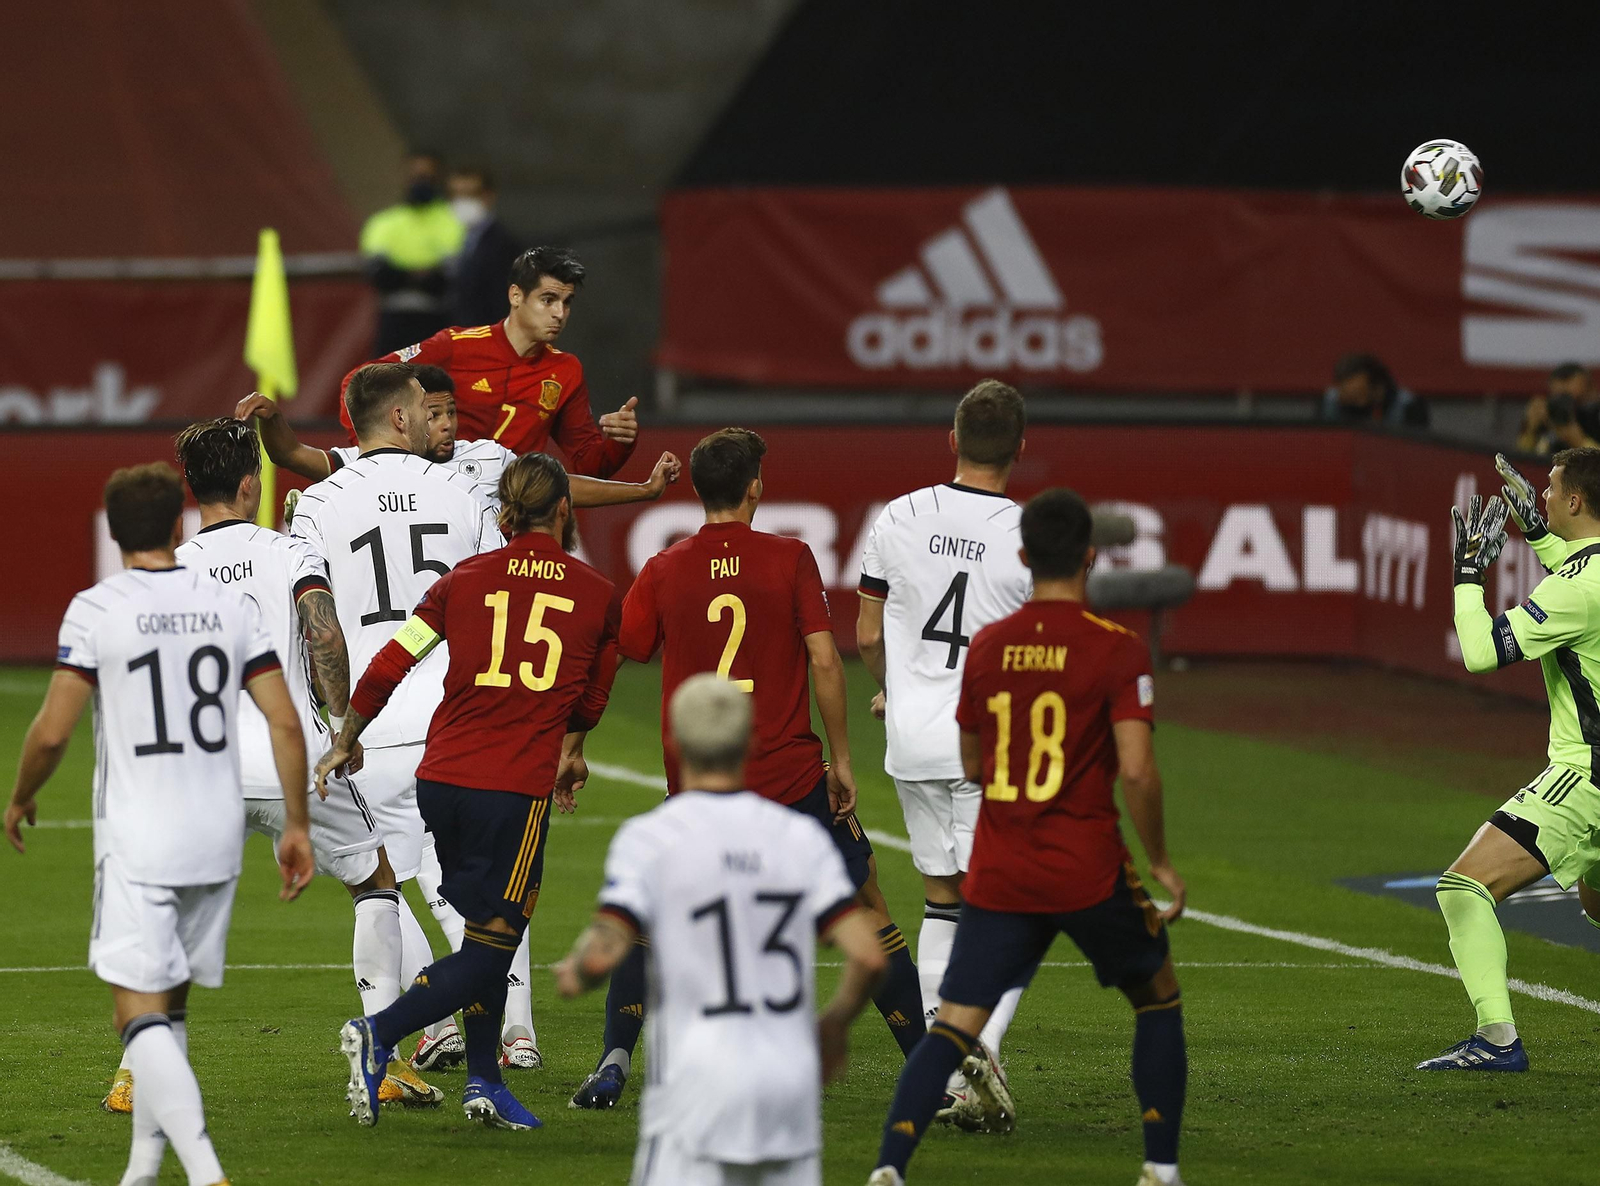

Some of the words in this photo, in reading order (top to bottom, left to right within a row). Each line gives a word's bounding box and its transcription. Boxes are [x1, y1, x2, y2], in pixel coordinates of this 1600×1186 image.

[847, 303, 1104, 371] adidas
[493, 403, 516, 440] 7
[378, 493, 417, 512] SÜLE
[209, 560, 253, 584] KOCH
[507, 558, 566, 581] RAMOS
[710, 556, 740, 580] PAU
[929, 534, 985, 562] GINTER
[1197, 504, 1359, 592] AL
[137, 612, 223, 635] GORETZKA
[475, 590, 575, 692] 15
[707, 593, 754, 693] 2
[921, 571, 969, 670] 4
[1002, 645, 1068, 672] FERRAN
[127, 644, 230, 757] 18
[984, 691, 1067, 802] 18
[691, 891, 804, 1017] 13
